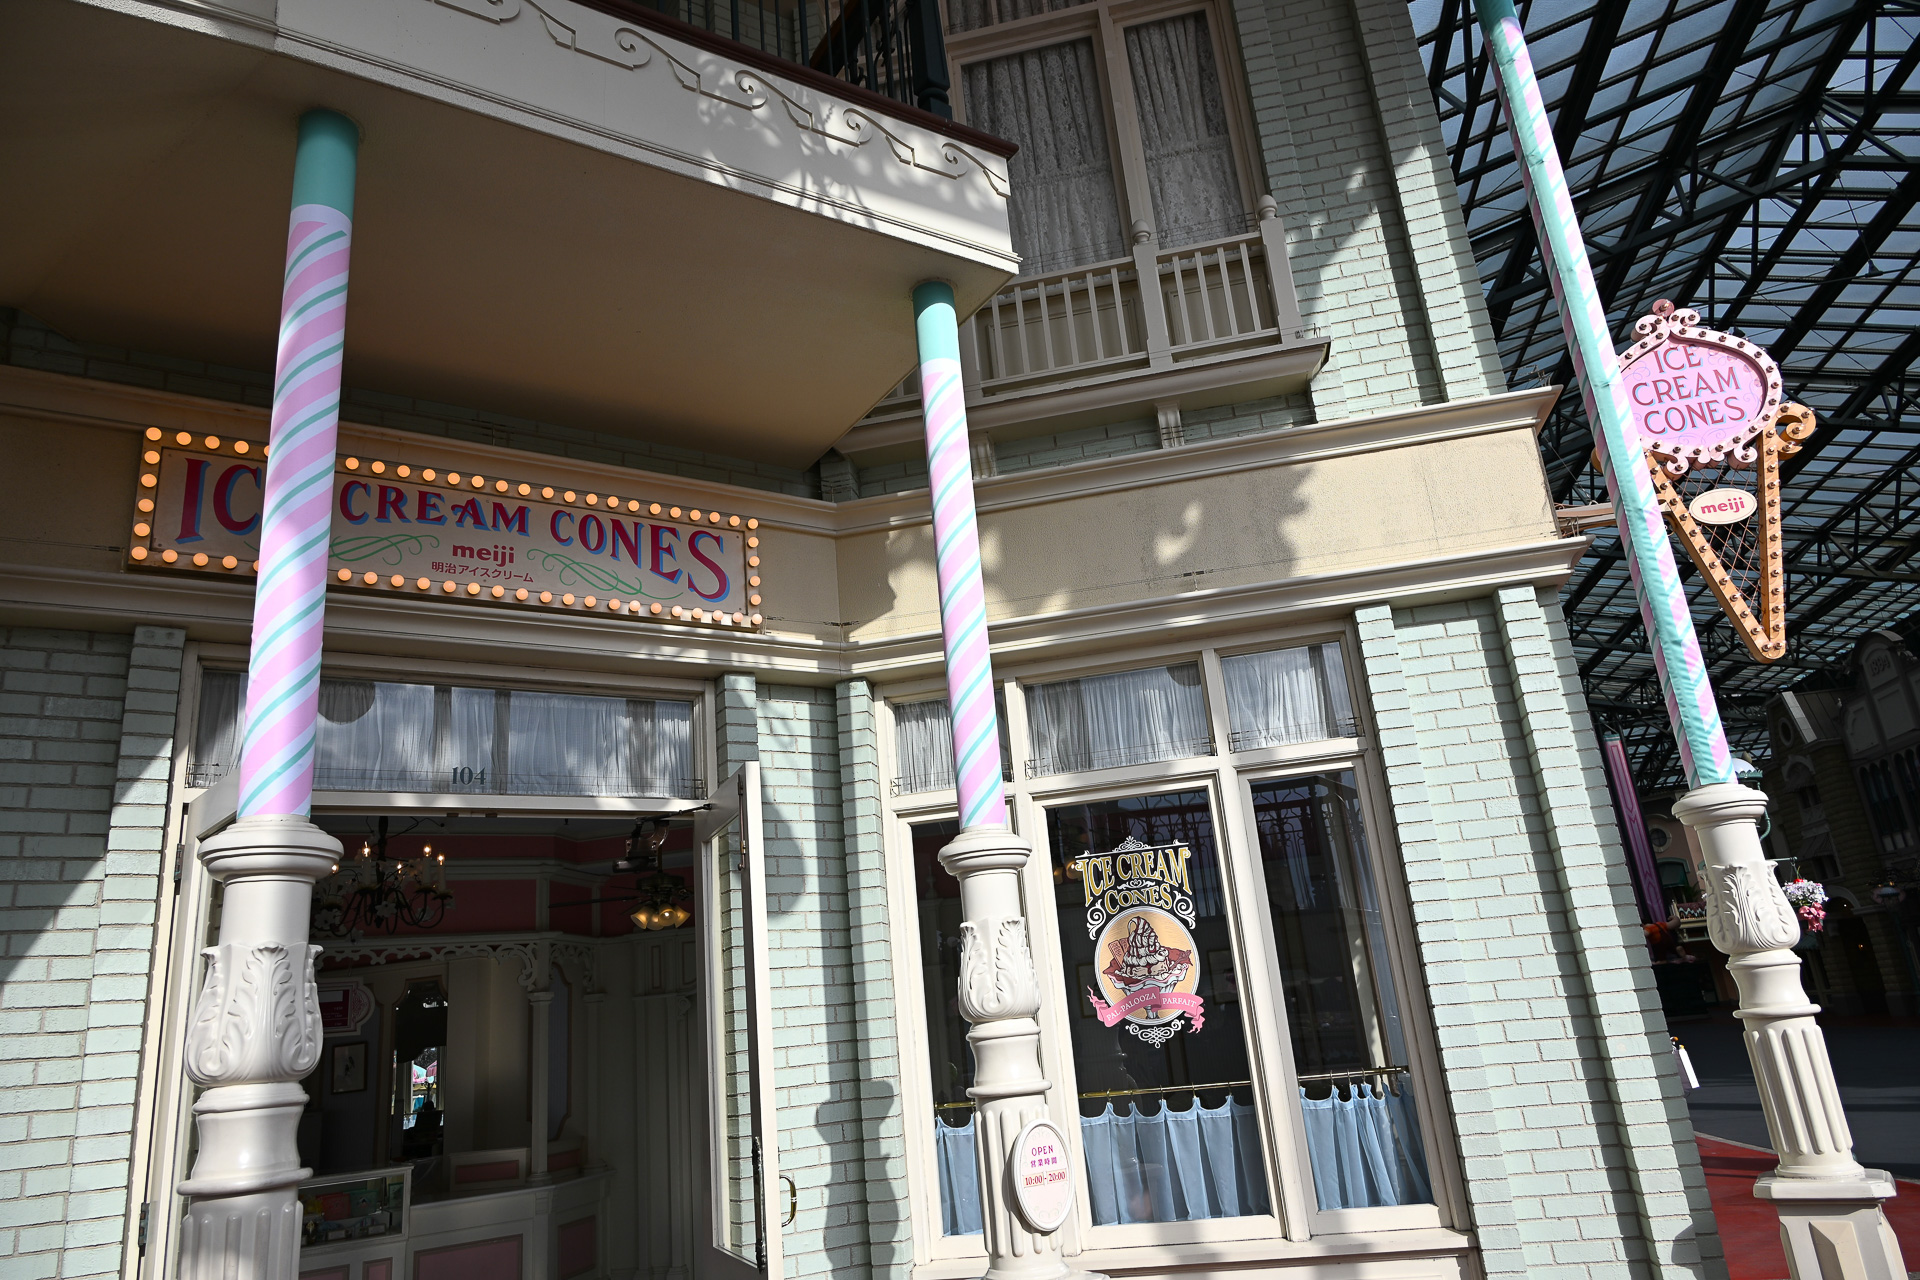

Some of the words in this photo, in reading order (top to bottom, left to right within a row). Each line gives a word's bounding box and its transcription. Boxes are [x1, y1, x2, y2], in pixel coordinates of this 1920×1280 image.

[1653, 345, 1703, 373] ICE
[1632, 366, 1742, 407] CREAM
[1644, 396, 1748, 436] CONES
[1700, 497, 1745, 514] meiji
[174, 457, 262, 545] IC
[339, 480, 531, 537] CREAM
[550, 509, 731, 603] CONES
[452, 544, 515, 567] meiji
[431, 561, 534, 583] 明治アイスクリーム
[451, 766, 487, 786] 104
[1075, 857, 1115, 907] ICE
[1116, 847, 1192, 895] CREAM
[1104, 883, 1173, 914] CONES
[1106, 992, 1157, 1022] PAL-PALOOZA
[1162, 997, 1197, 1008] PARFAIT
[1030, 1156, 1058, 1168] 営業時間
[1031, 1144, 1054, 1157] OPEN
